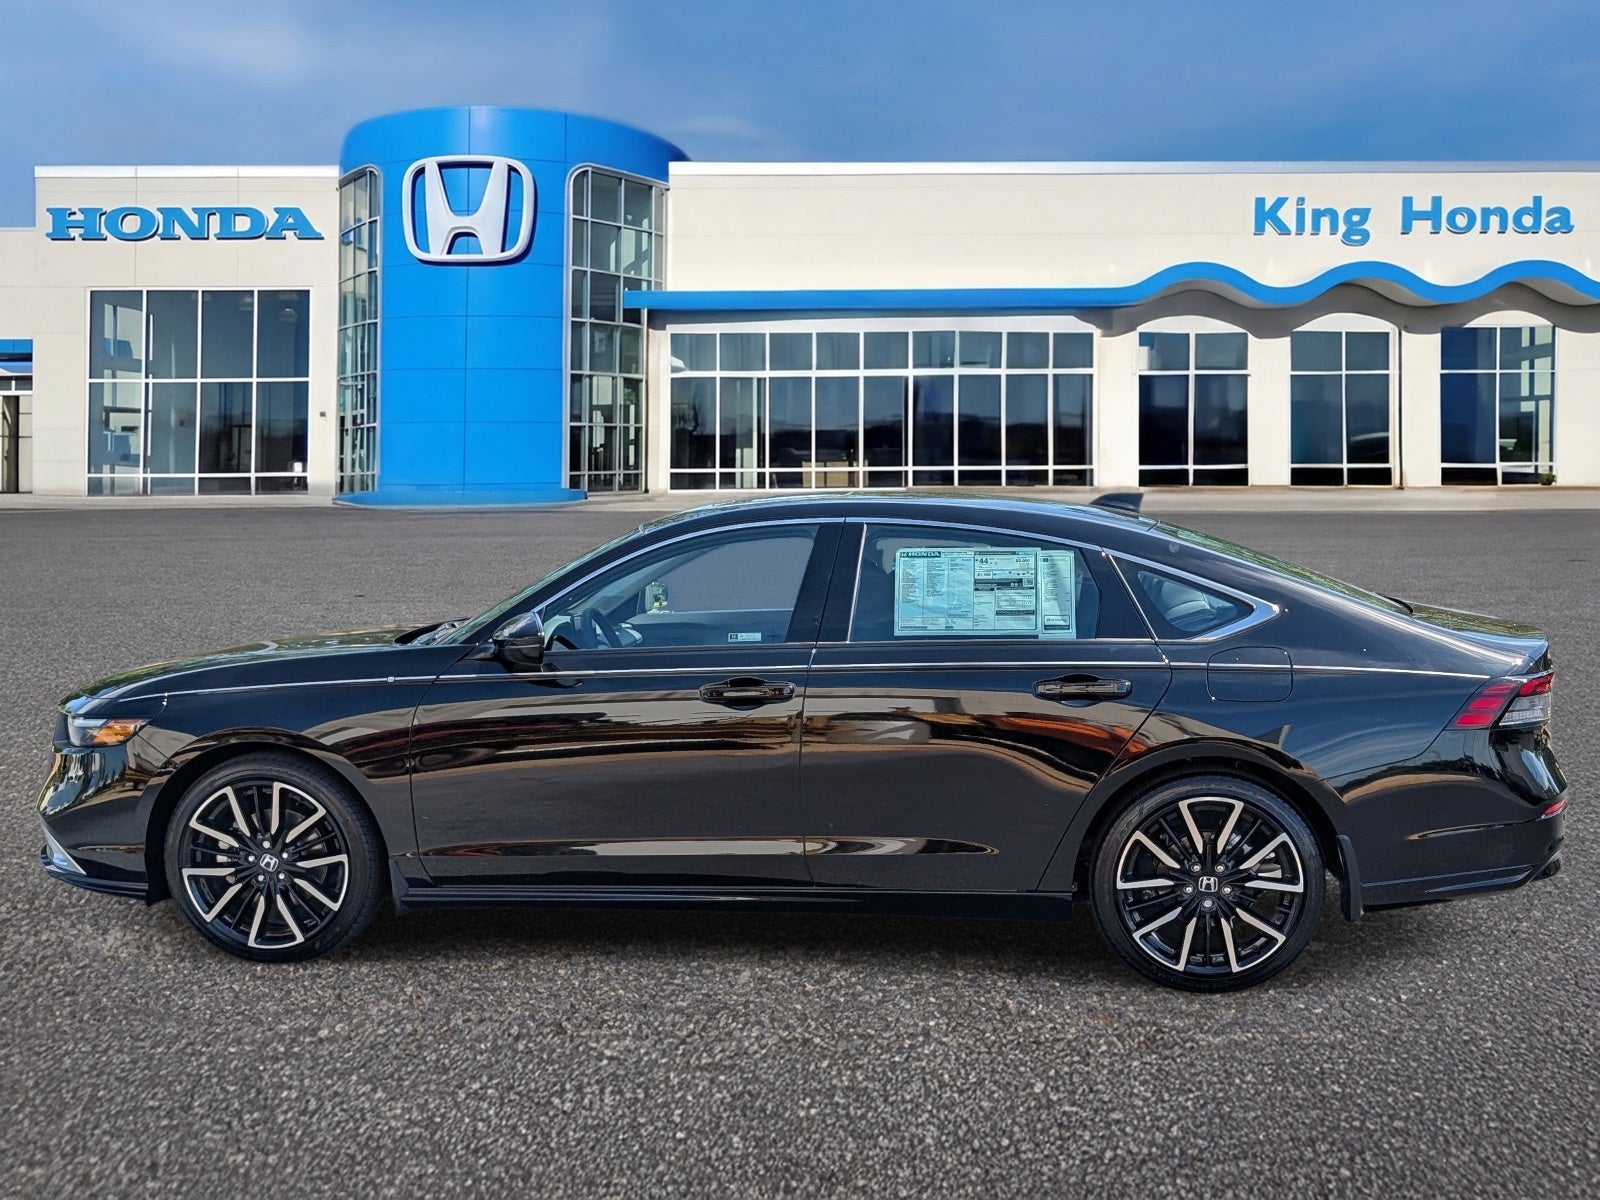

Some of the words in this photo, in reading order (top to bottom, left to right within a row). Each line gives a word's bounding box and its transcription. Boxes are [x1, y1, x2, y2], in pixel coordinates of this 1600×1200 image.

[46, 207, 324, 241] HONDA
[1254, 196, 1372, 246] King
[1400, 195, 1575, 234] Honda
